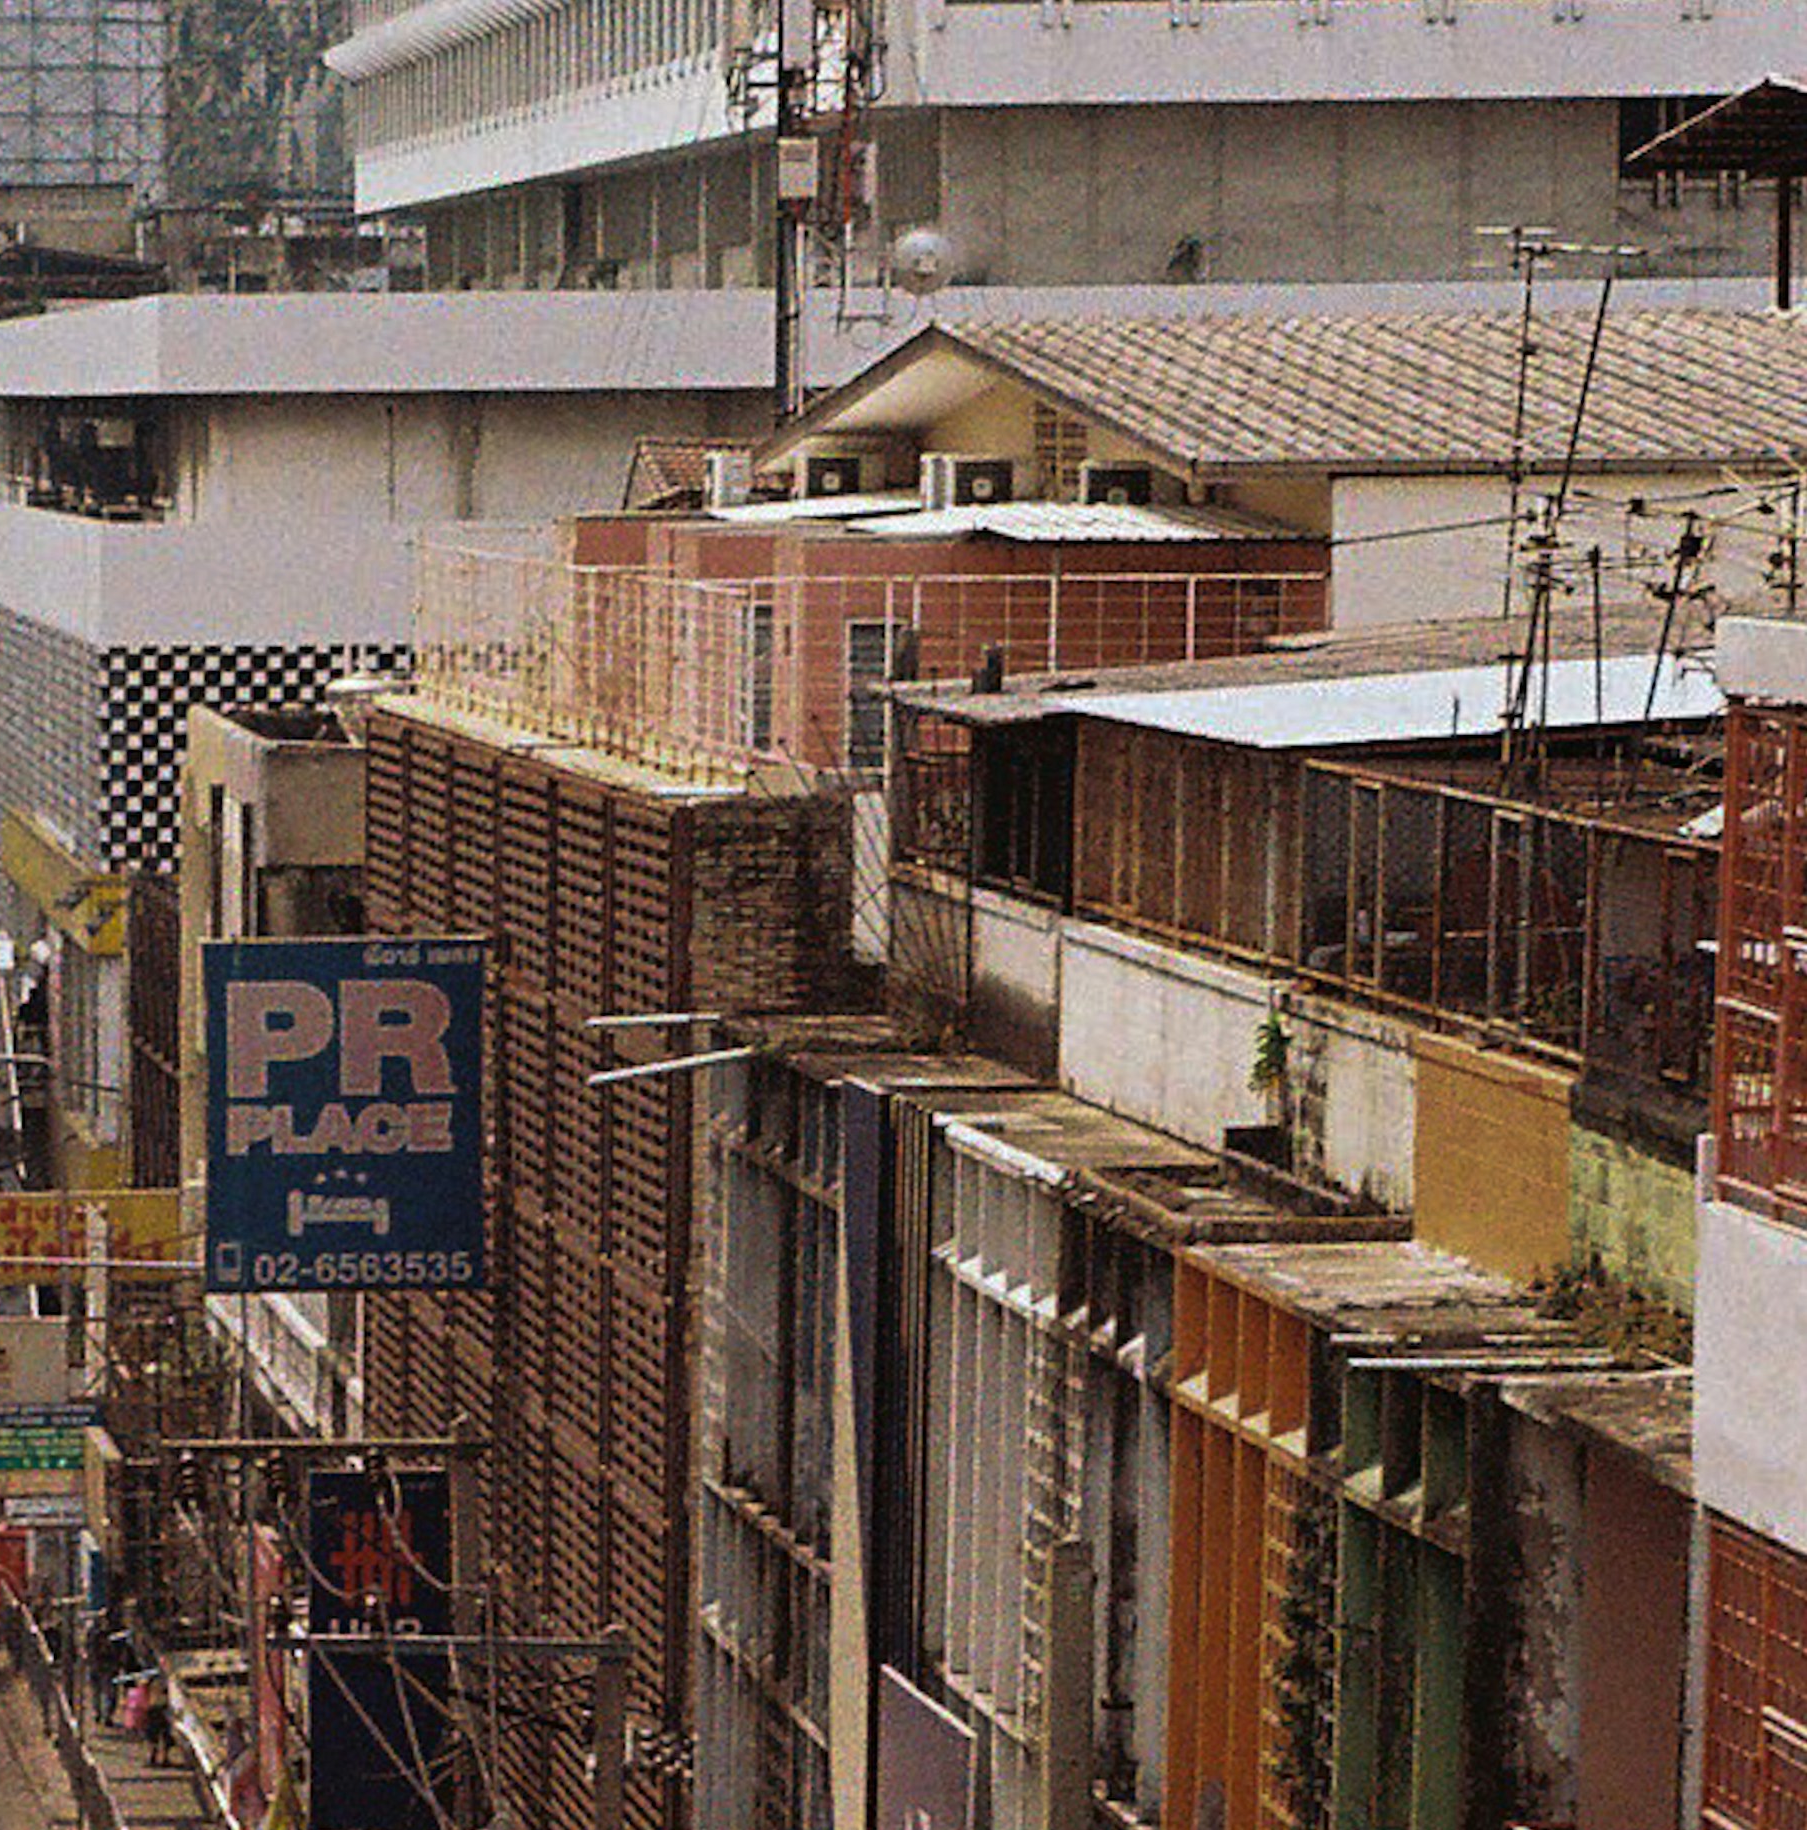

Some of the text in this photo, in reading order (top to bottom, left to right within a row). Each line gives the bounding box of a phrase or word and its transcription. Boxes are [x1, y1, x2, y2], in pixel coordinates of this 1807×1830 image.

[225, 979, 458, 1098] PR
[225, 1102, 454, 1157] PLACE
[253, 1253, 474, 1286] 02-6563535
